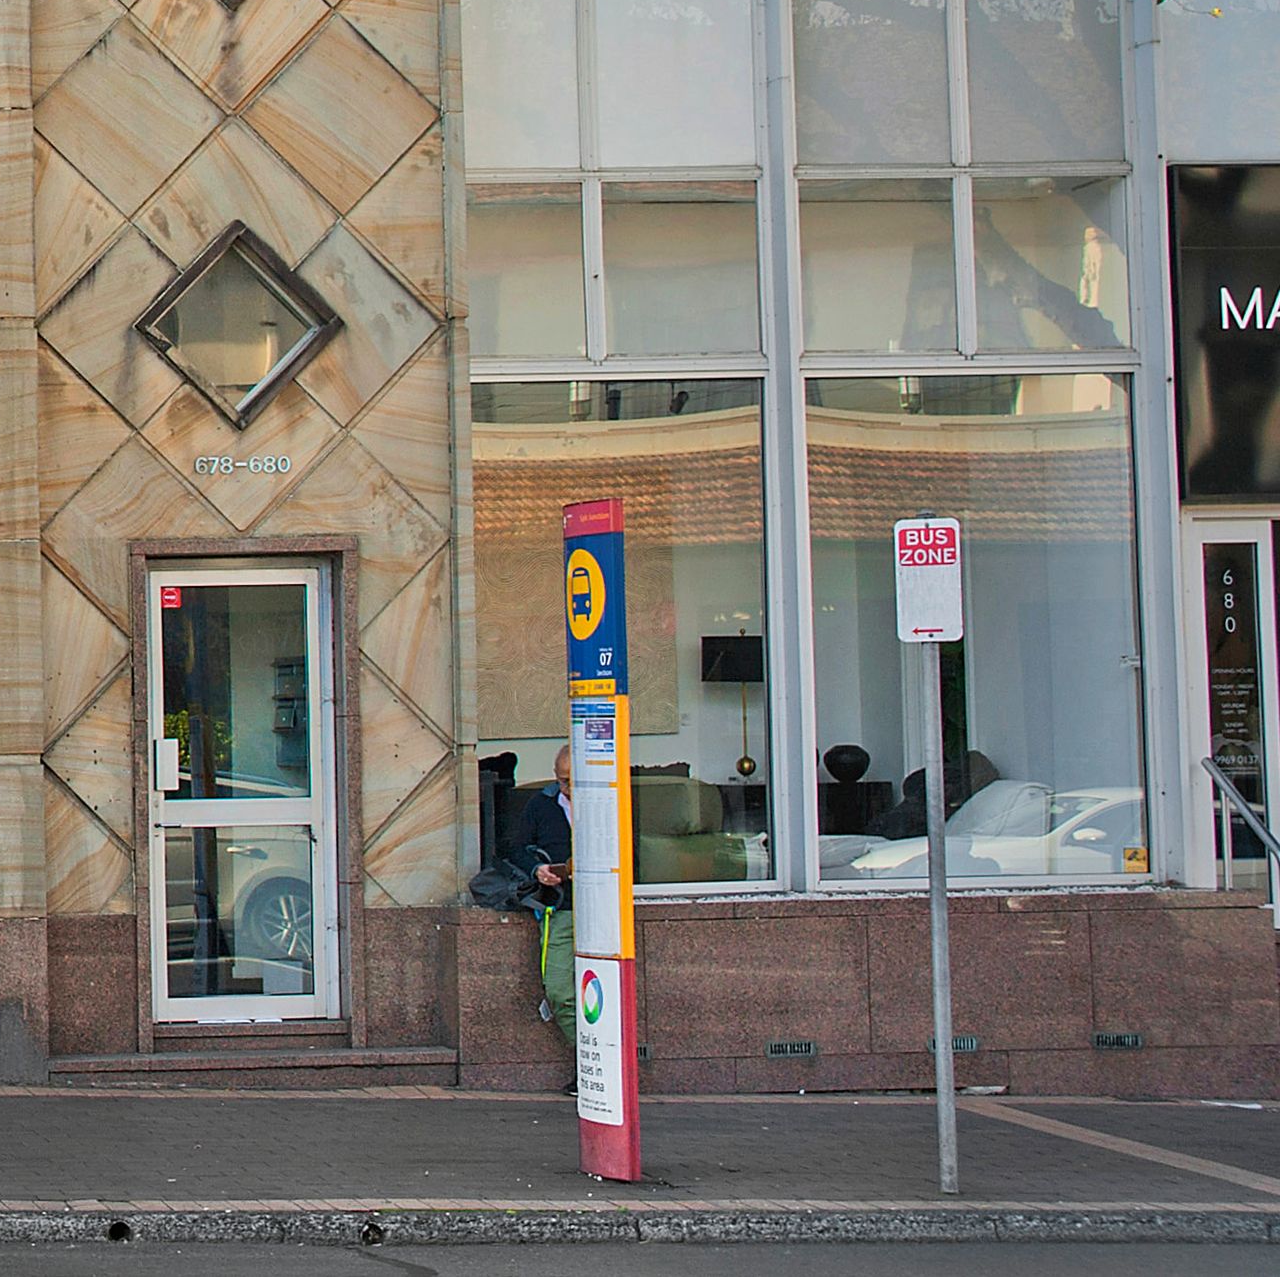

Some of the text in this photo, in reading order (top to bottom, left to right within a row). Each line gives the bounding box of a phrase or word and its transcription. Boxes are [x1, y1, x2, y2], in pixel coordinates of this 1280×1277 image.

[195, 456, 291, 474] 678-680
[905, 529, 948, 545] BUS
[900, 548, 956, 564] ZONE
[599, 652, 613, 666] 07
[592, 1033, 598, 1047] is
[591, 1052, 601, 1062] on
[595, 1065, 603, 1077] in
[590, 1081, 605, 1093] area
